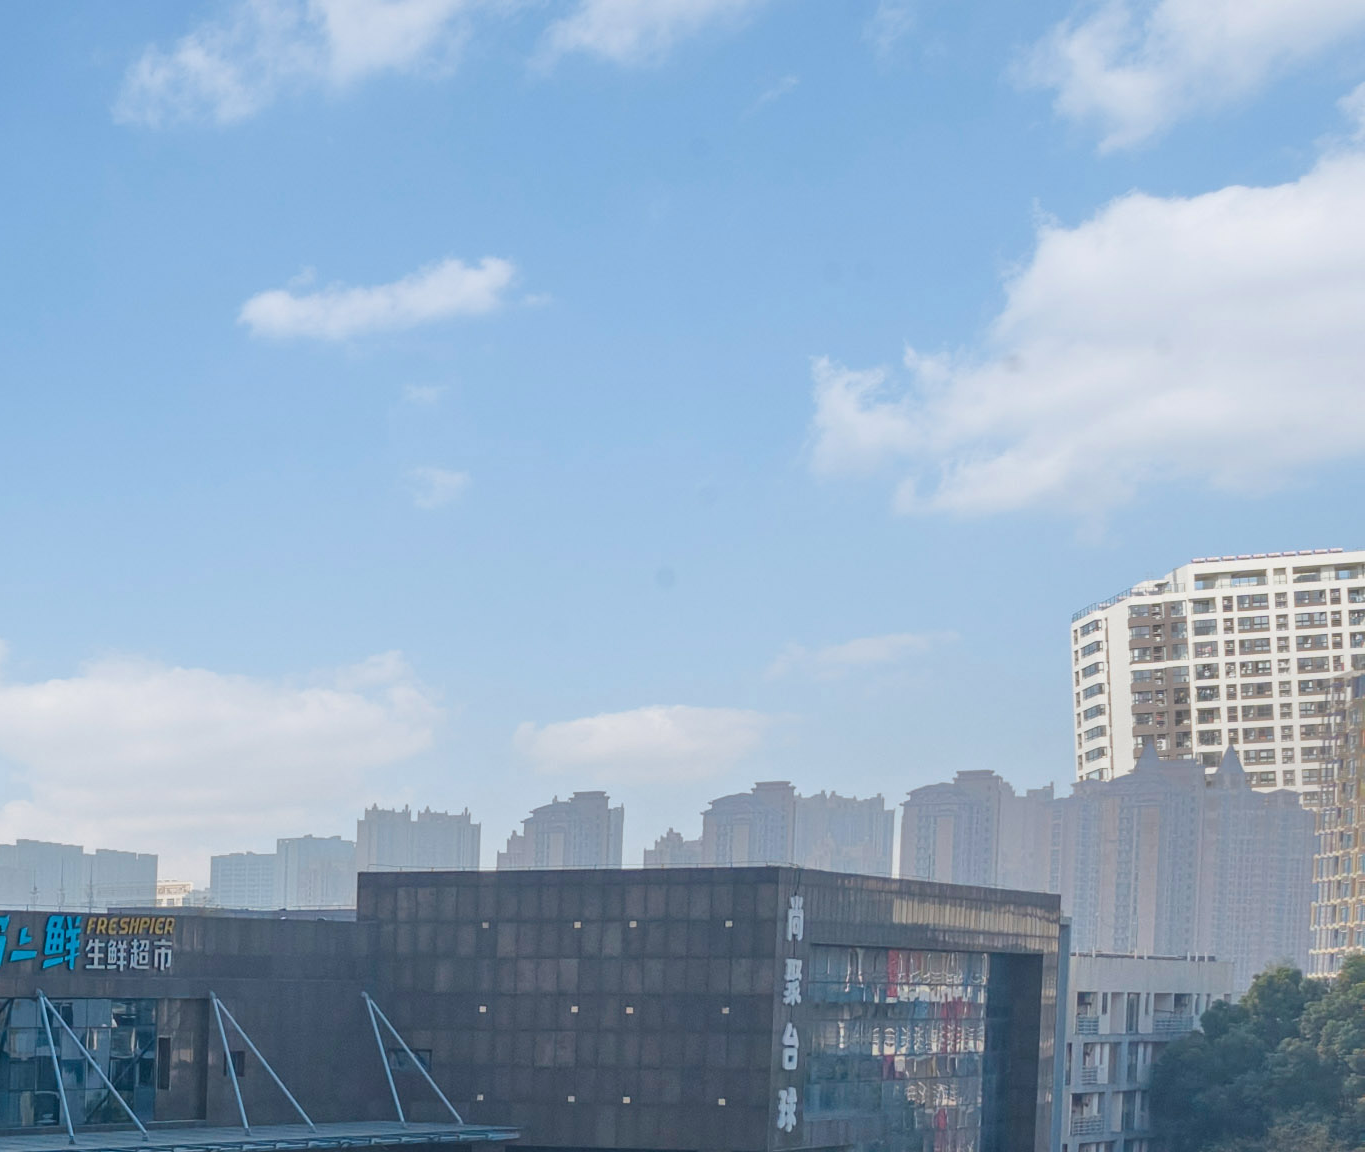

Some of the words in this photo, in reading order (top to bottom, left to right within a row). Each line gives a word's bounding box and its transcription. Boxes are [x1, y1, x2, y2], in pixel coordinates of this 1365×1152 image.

[86, 917, 176, 935] FRESHPIER
[85, 938, 173, 971] 生鲜超市
[777, 895, 805, 1133] 尚聚台球
